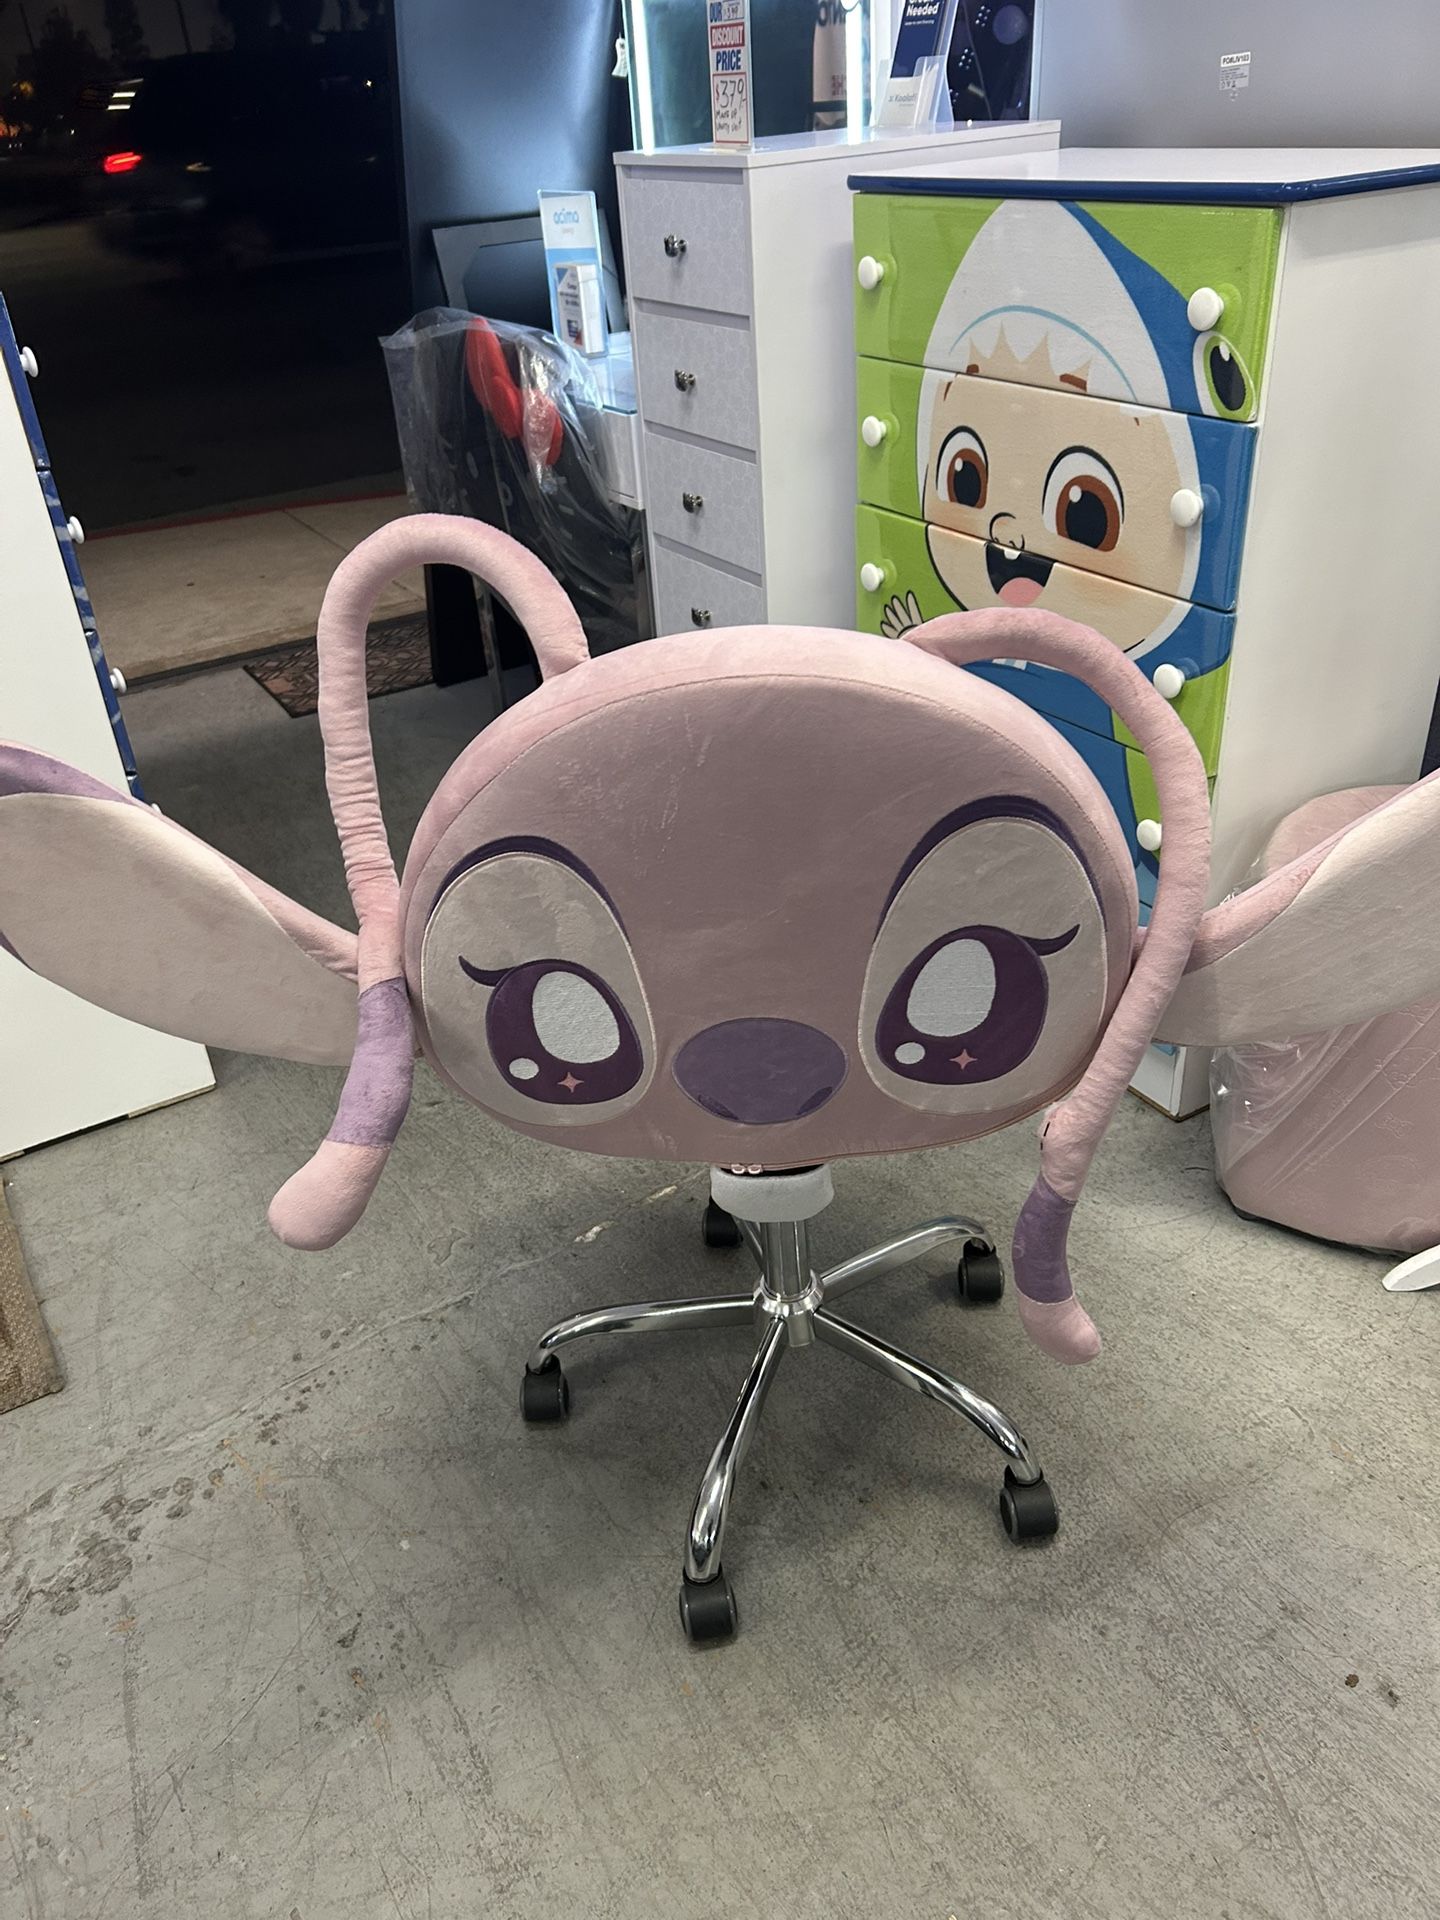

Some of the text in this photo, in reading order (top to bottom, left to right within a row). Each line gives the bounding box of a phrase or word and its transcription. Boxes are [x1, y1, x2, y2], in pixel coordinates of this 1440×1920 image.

[710, 2, 722, 22] OUR
[906, 2, 940, 17] Needed
[712, 26, 744, 46] DISCOUNT
[716, 49, 742, 71] PRICE
[553, 208, 580, 224] acima
